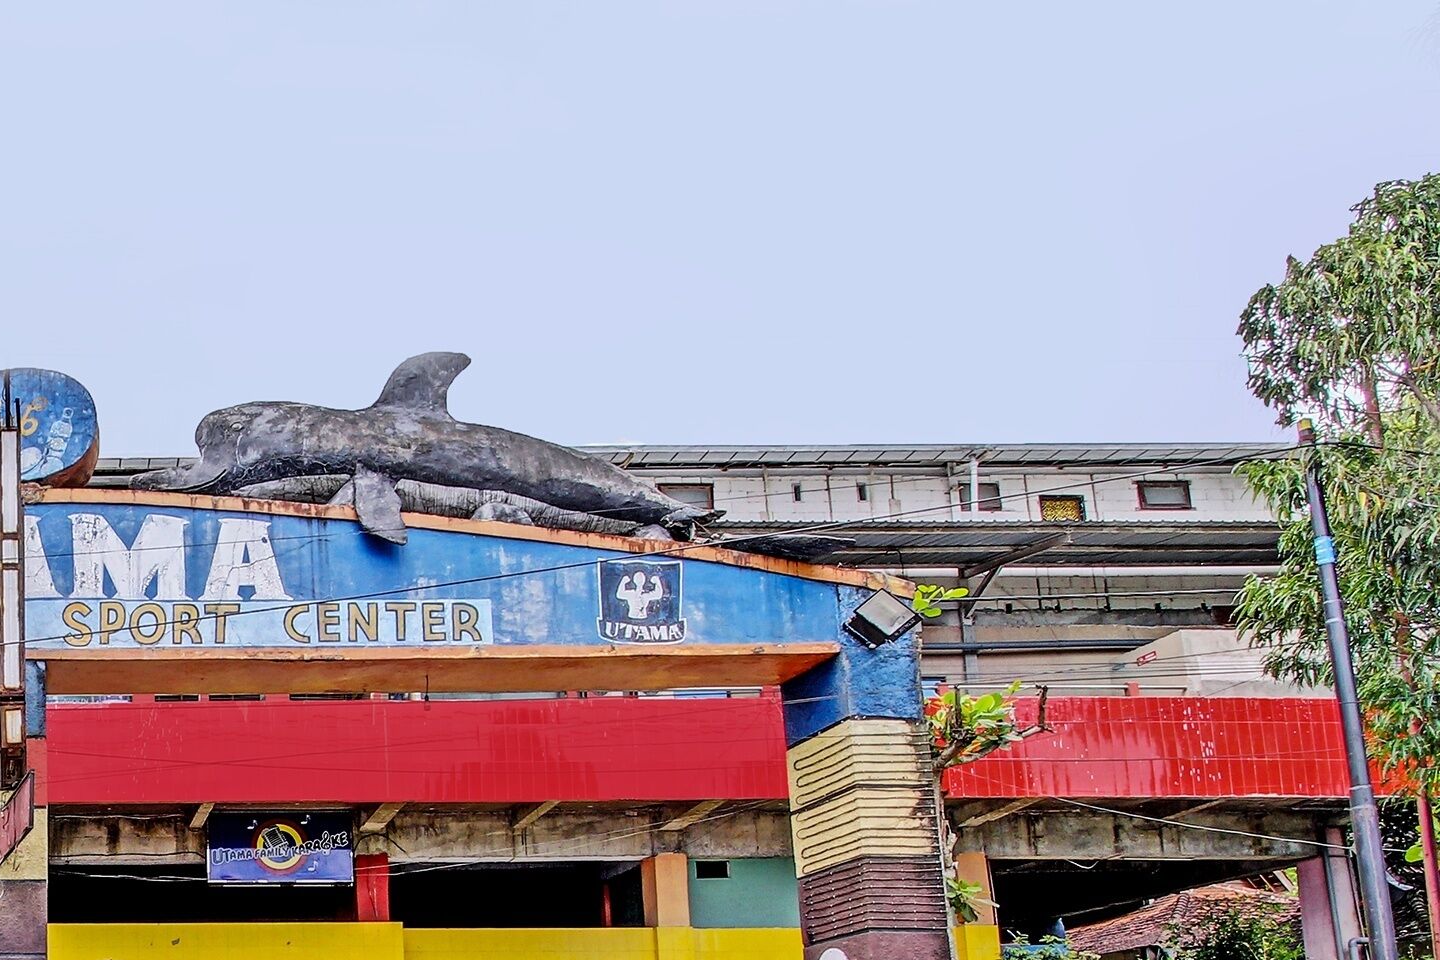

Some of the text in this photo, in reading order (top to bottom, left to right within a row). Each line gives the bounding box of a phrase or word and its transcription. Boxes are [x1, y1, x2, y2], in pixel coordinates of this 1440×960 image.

[61, 602, 244, 647] SPORT
[282, 602, 484, 645] CENTER
[605, 621, 683, 641] UTAMA
[212, 847, 253, 865] UTAMA
[254, 845, 291, 860] FAMILY
